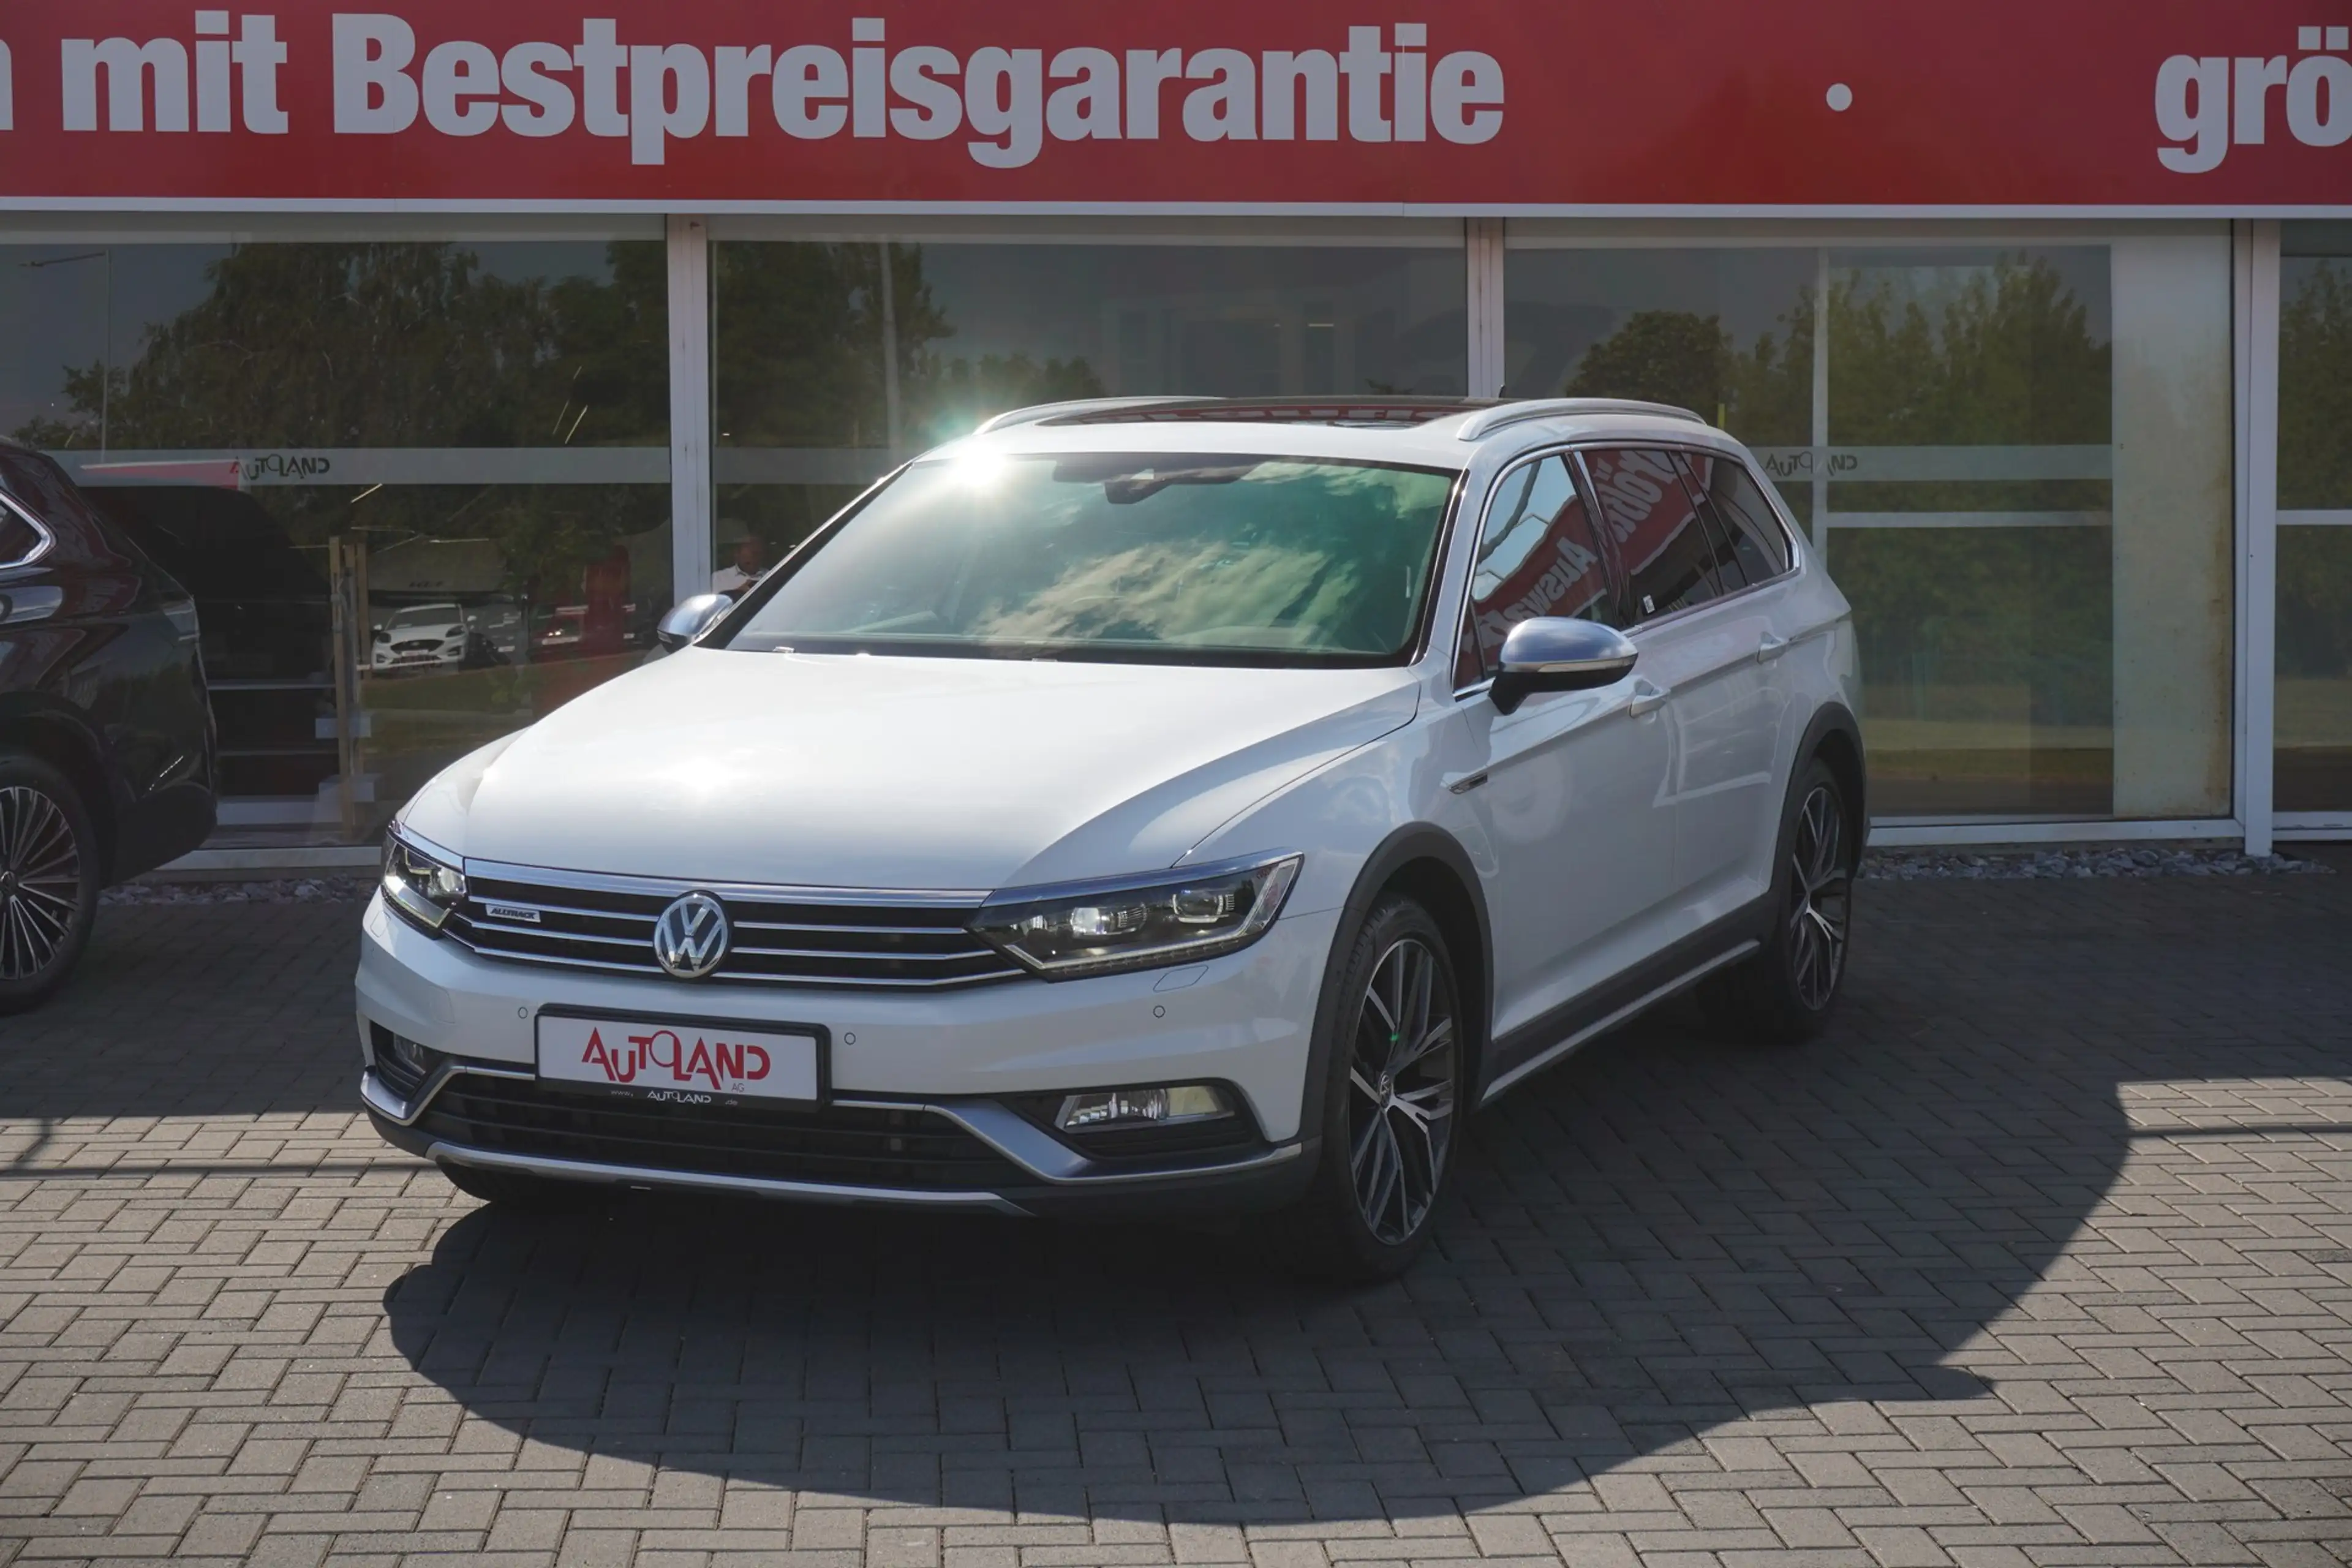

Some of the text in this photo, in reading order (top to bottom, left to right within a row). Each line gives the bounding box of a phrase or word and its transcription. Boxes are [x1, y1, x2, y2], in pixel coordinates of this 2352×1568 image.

[61, 10, 288, 134] mit
[332, 13, 1504, 168] Bestpreisgarantie
[731, 1083, 745, 1093] AG
